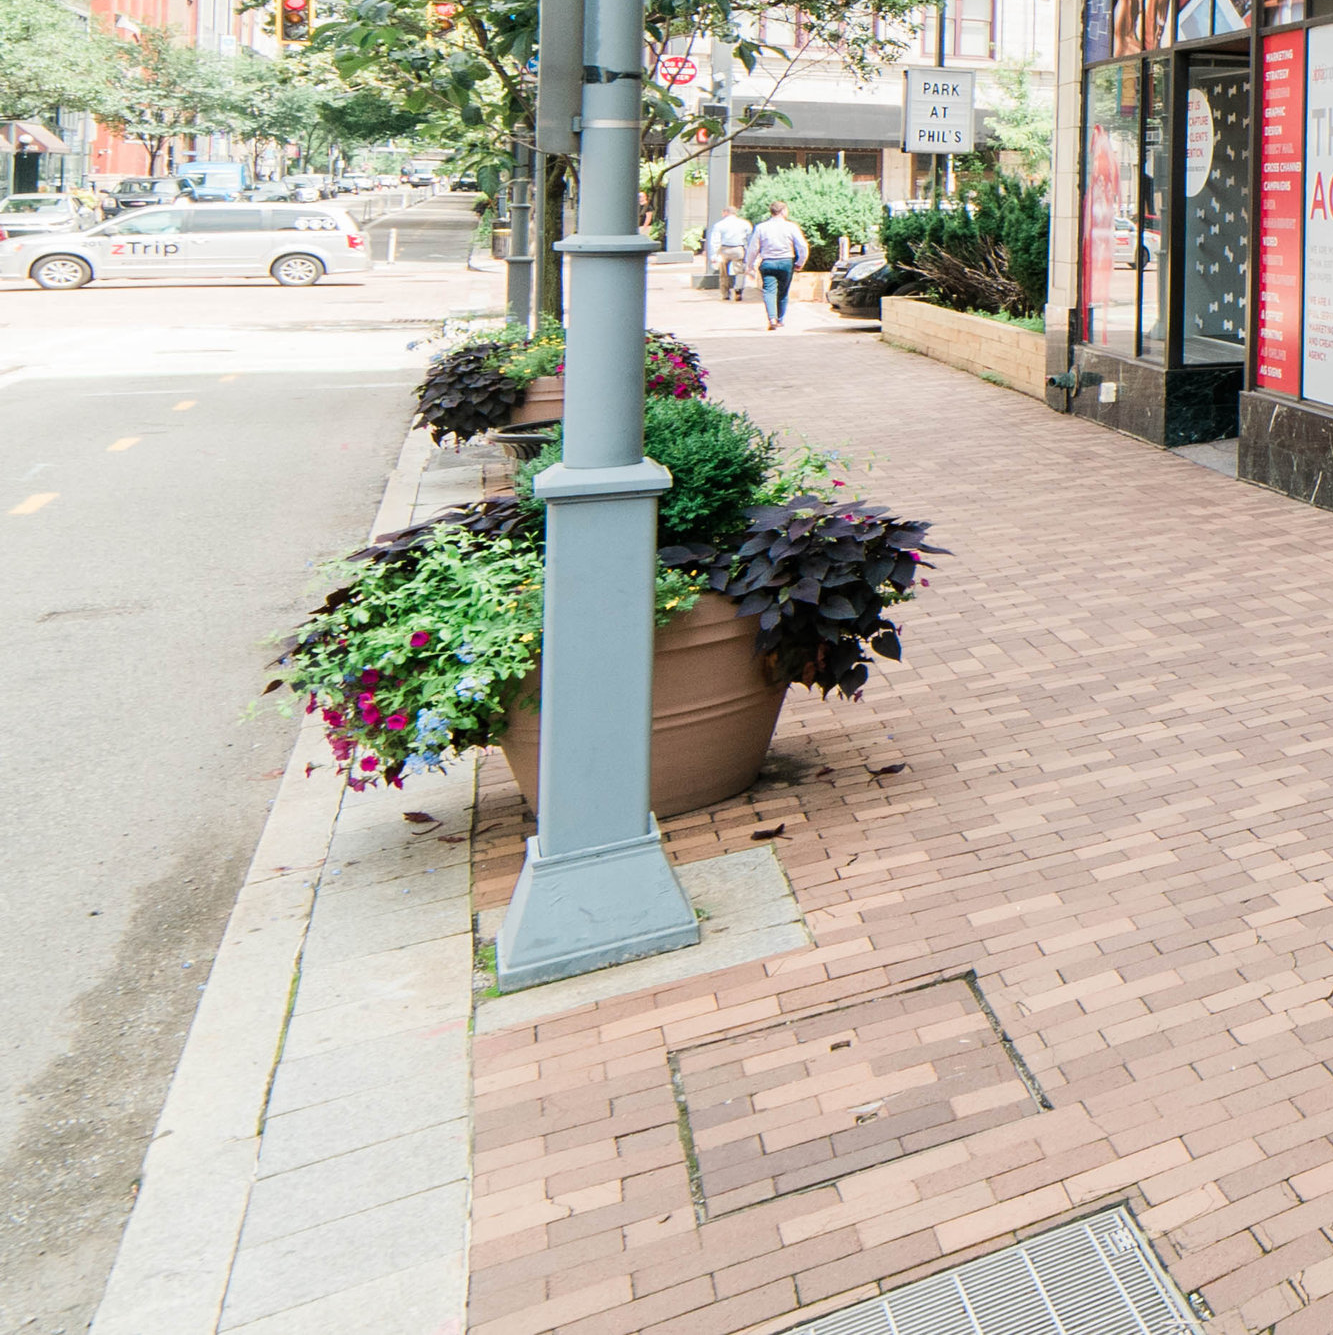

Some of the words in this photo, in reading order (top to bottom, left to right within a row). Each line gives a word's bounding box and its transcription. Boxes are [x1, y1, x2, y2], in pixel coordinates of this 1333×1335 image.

[923, 82, 960, 96] PARK
[930, 106, 949, 118] AT
[918, 129, 962, 143] PHIL'S
[111, 240, 180, 257] zTrip
